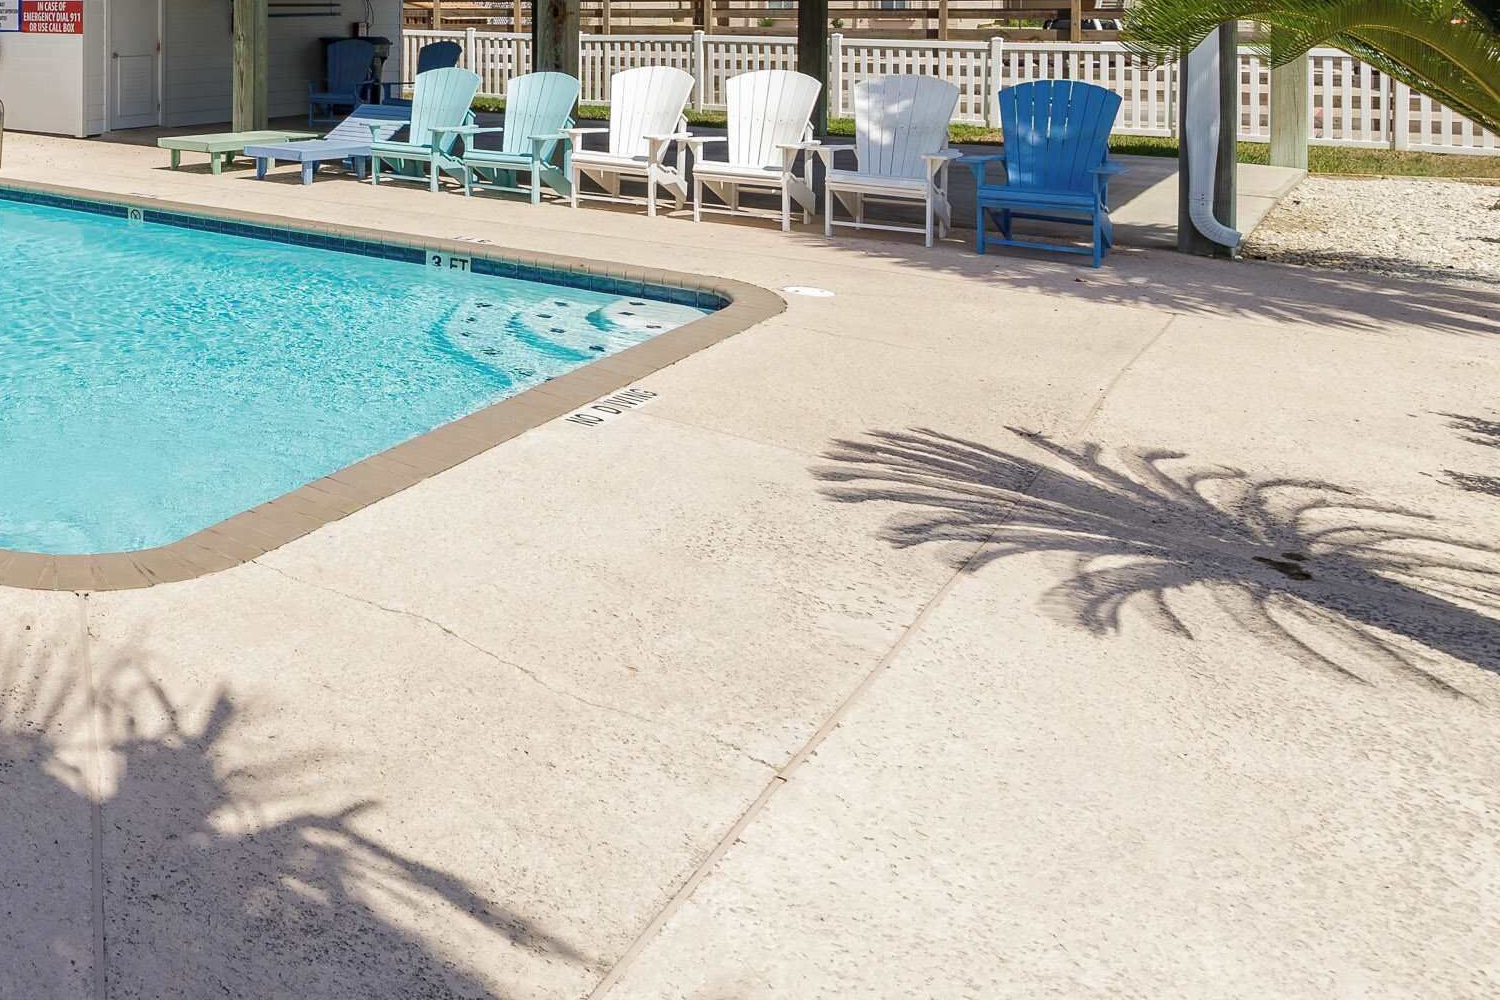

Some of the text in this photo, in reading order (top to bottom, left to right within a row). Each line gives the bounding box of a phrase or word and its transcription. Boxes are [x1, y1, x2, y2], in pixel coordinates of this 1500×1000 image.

[37, 1, 67, 12] IN CASE OF
[23, 11, 56, 22] EMERGENCY
[56, 11, 69, 22] DIAL
[70, 12, 81, 22] 911
[29, 22, 75, 33] OR USE CALL BOX
[432, 255, 469, 271] 3 FT
[564, 388, 658, 427] NO DIVING
